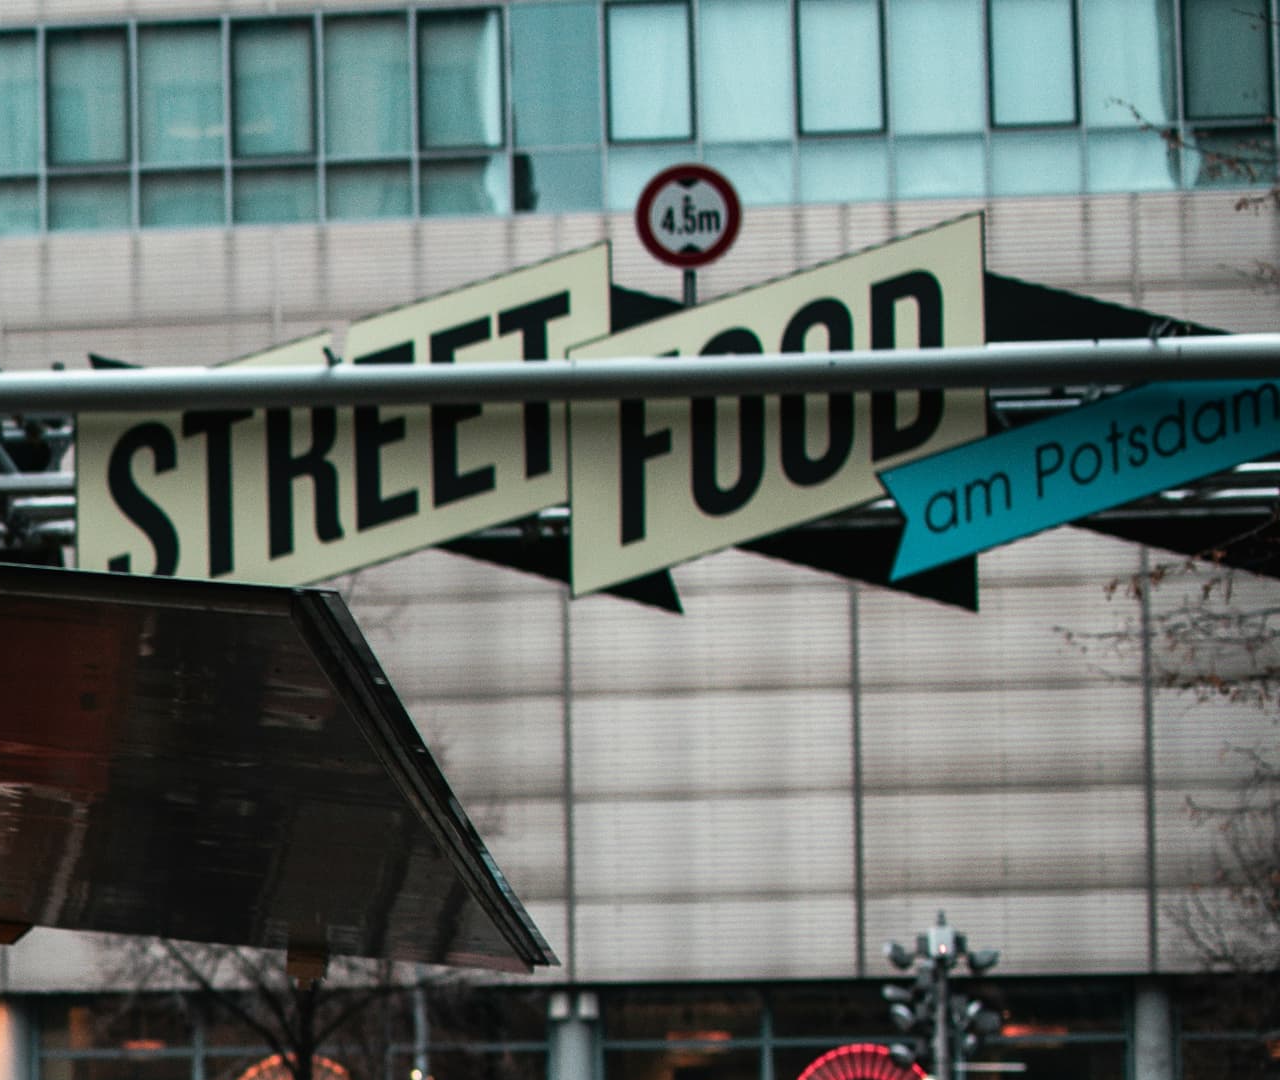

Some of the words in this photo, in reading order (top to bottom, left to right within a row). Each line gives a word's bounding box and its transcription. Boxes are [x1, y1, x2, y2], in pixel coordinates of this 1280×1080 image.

[661, 205, 721, 234] 4.5m
[107, 289, 571, 578] STREET
[618, 269, 945, 548] FOOD
[924, 470, 1012, 533] am
